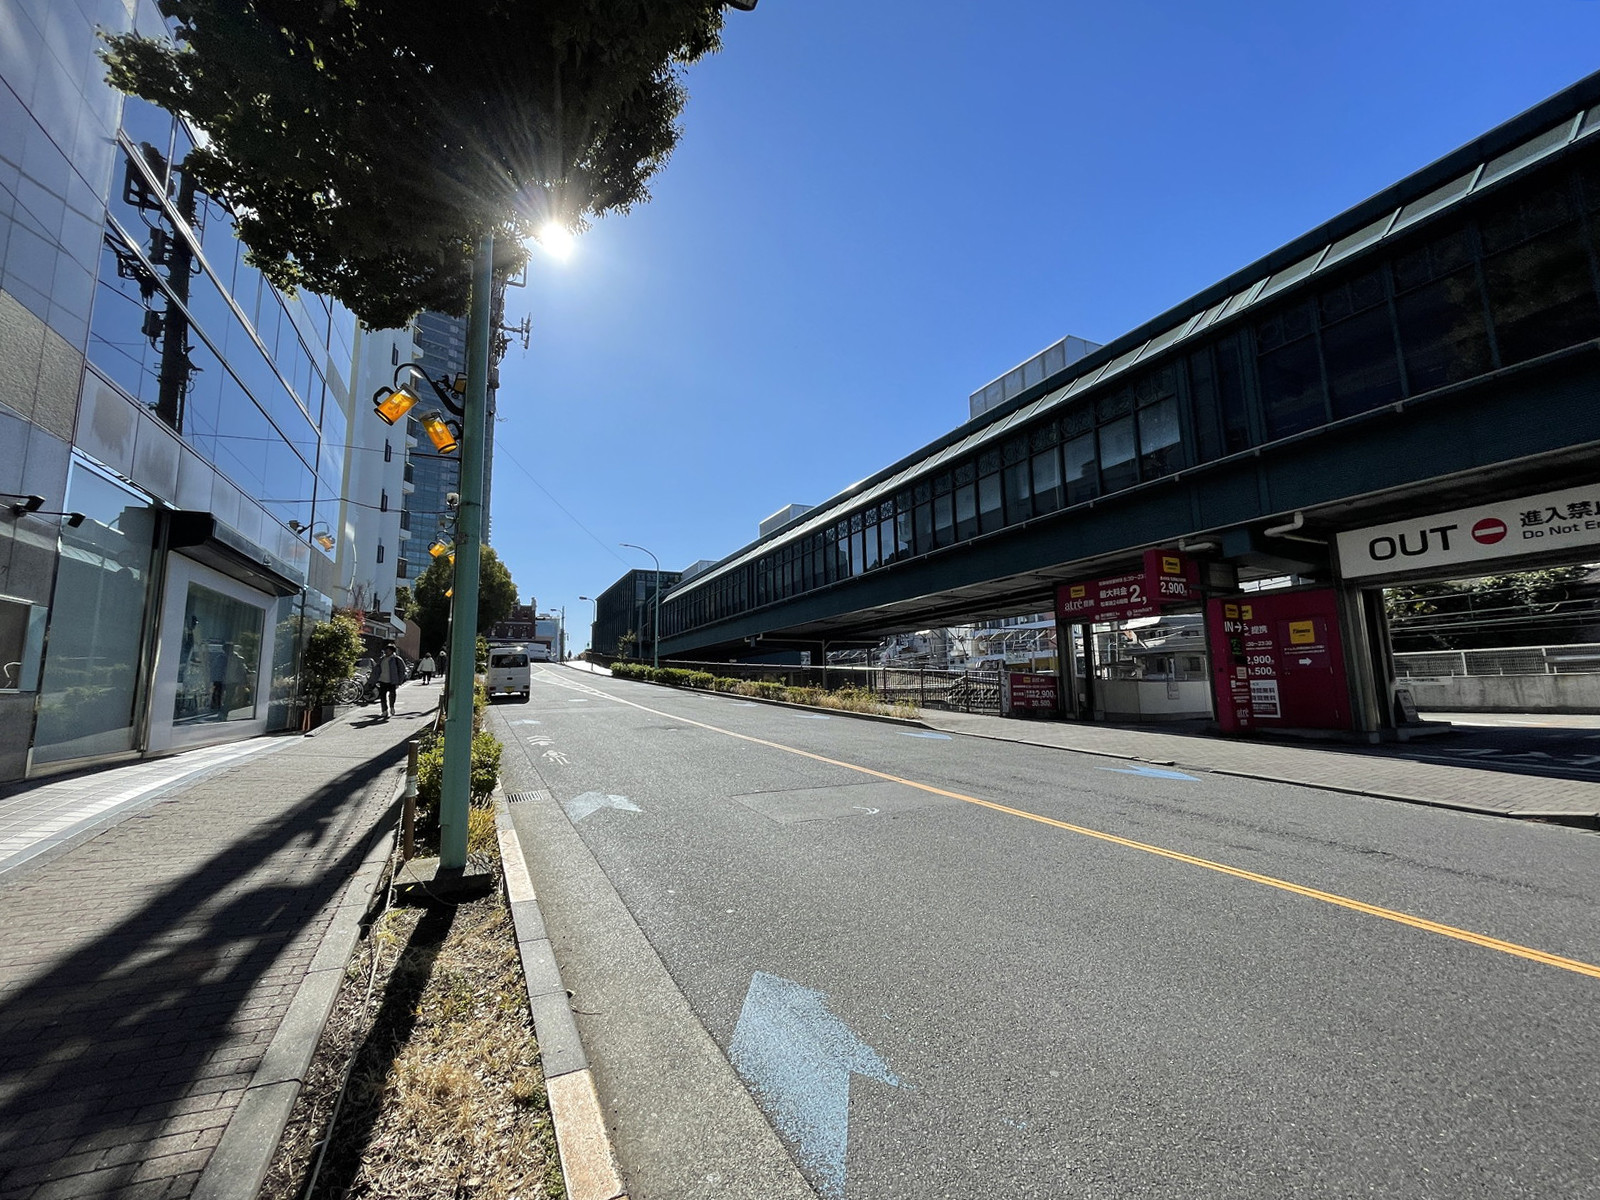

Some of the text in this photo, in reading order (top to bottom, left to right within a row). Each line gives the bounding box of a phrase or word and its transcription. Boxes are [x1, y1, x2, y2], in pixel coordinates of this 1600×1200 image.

[1523, 520, 1600, 539] Do Not E
[1369, 524, 1458, 561] OUT
[1224, 621, 1233, 632] IN
